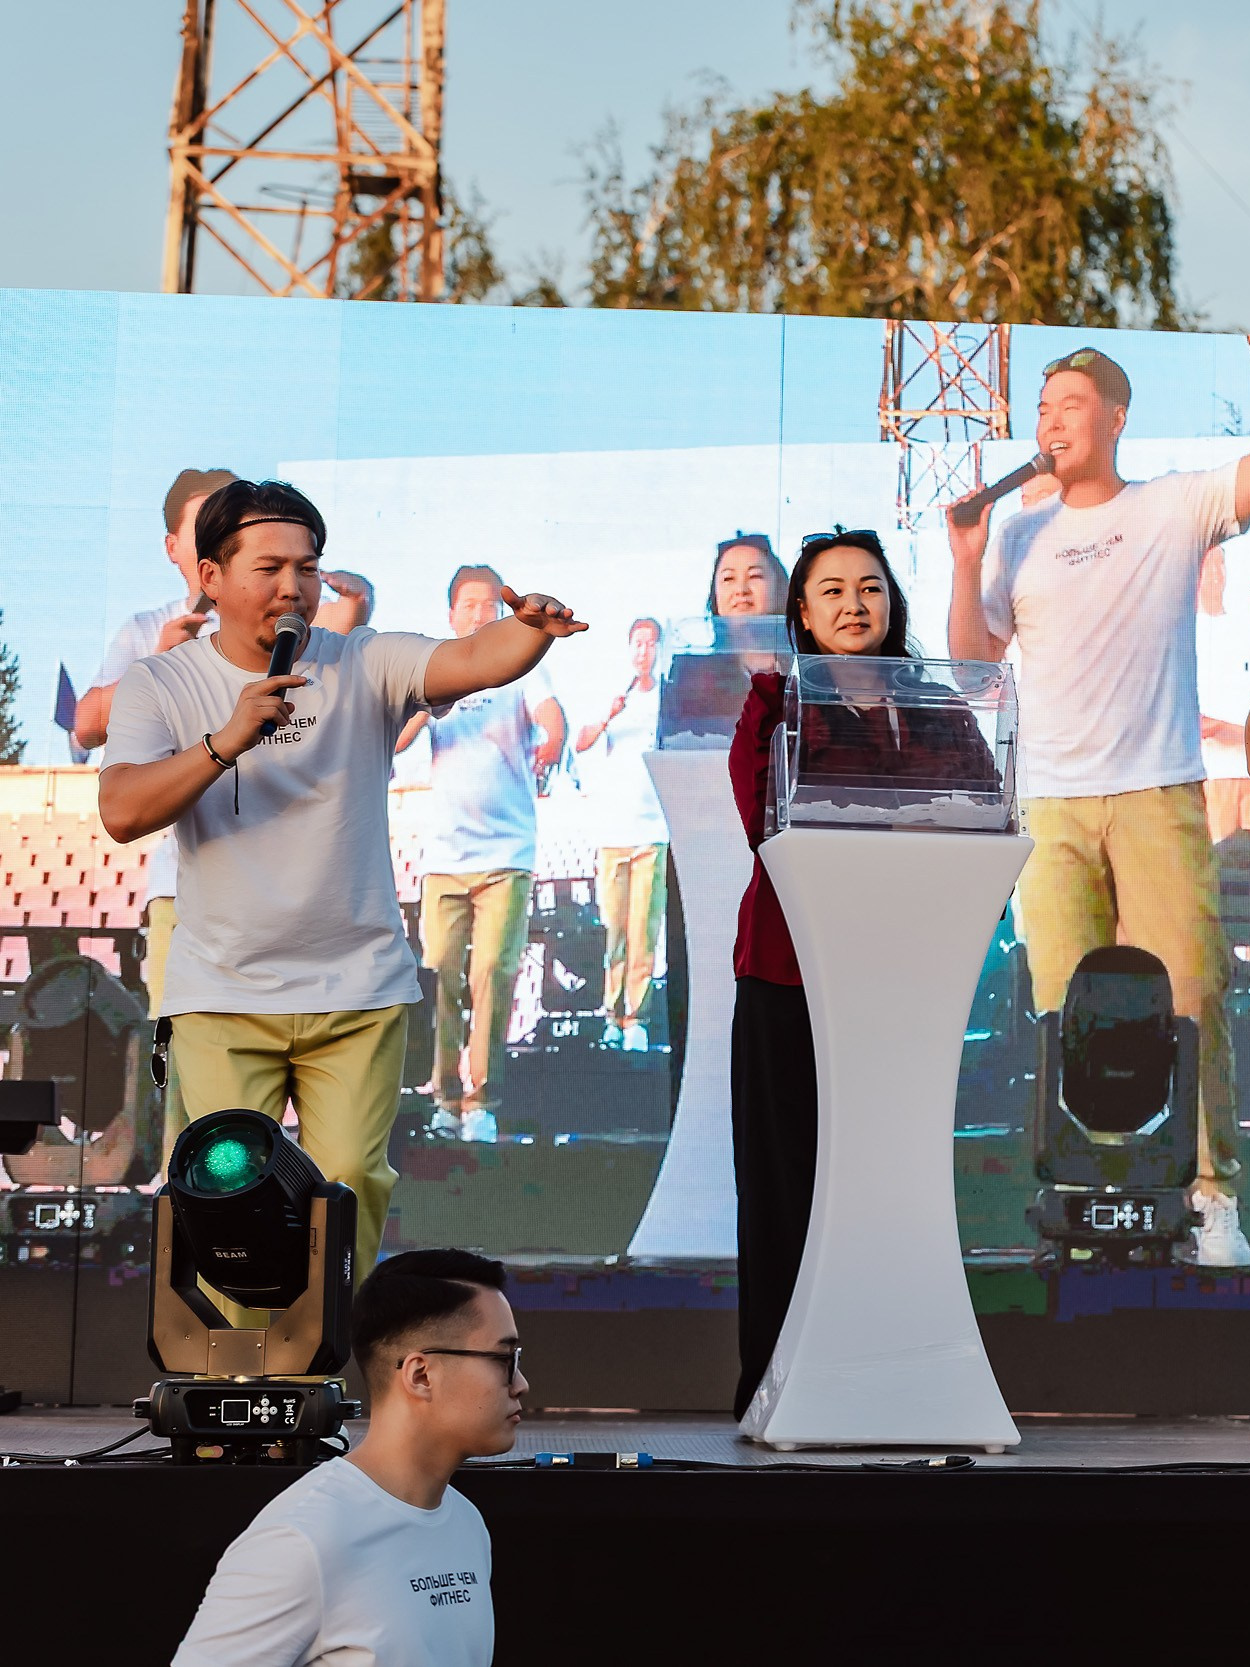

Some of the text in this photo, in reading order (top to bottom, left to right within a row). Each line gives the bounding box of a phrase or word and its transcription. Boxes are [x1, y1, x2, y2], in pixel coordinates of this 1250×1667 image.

[289, 715, 317, 730] ЧЕМ
[257, 731, 302, 746] ИТНЕС
[215, 1251, 248, 1259] BEAM
[410, 1571, 478, 1592] БОЛЬШЕ ЧЕМ
[429, 1589, 471, 1607] ФИТНЕС
